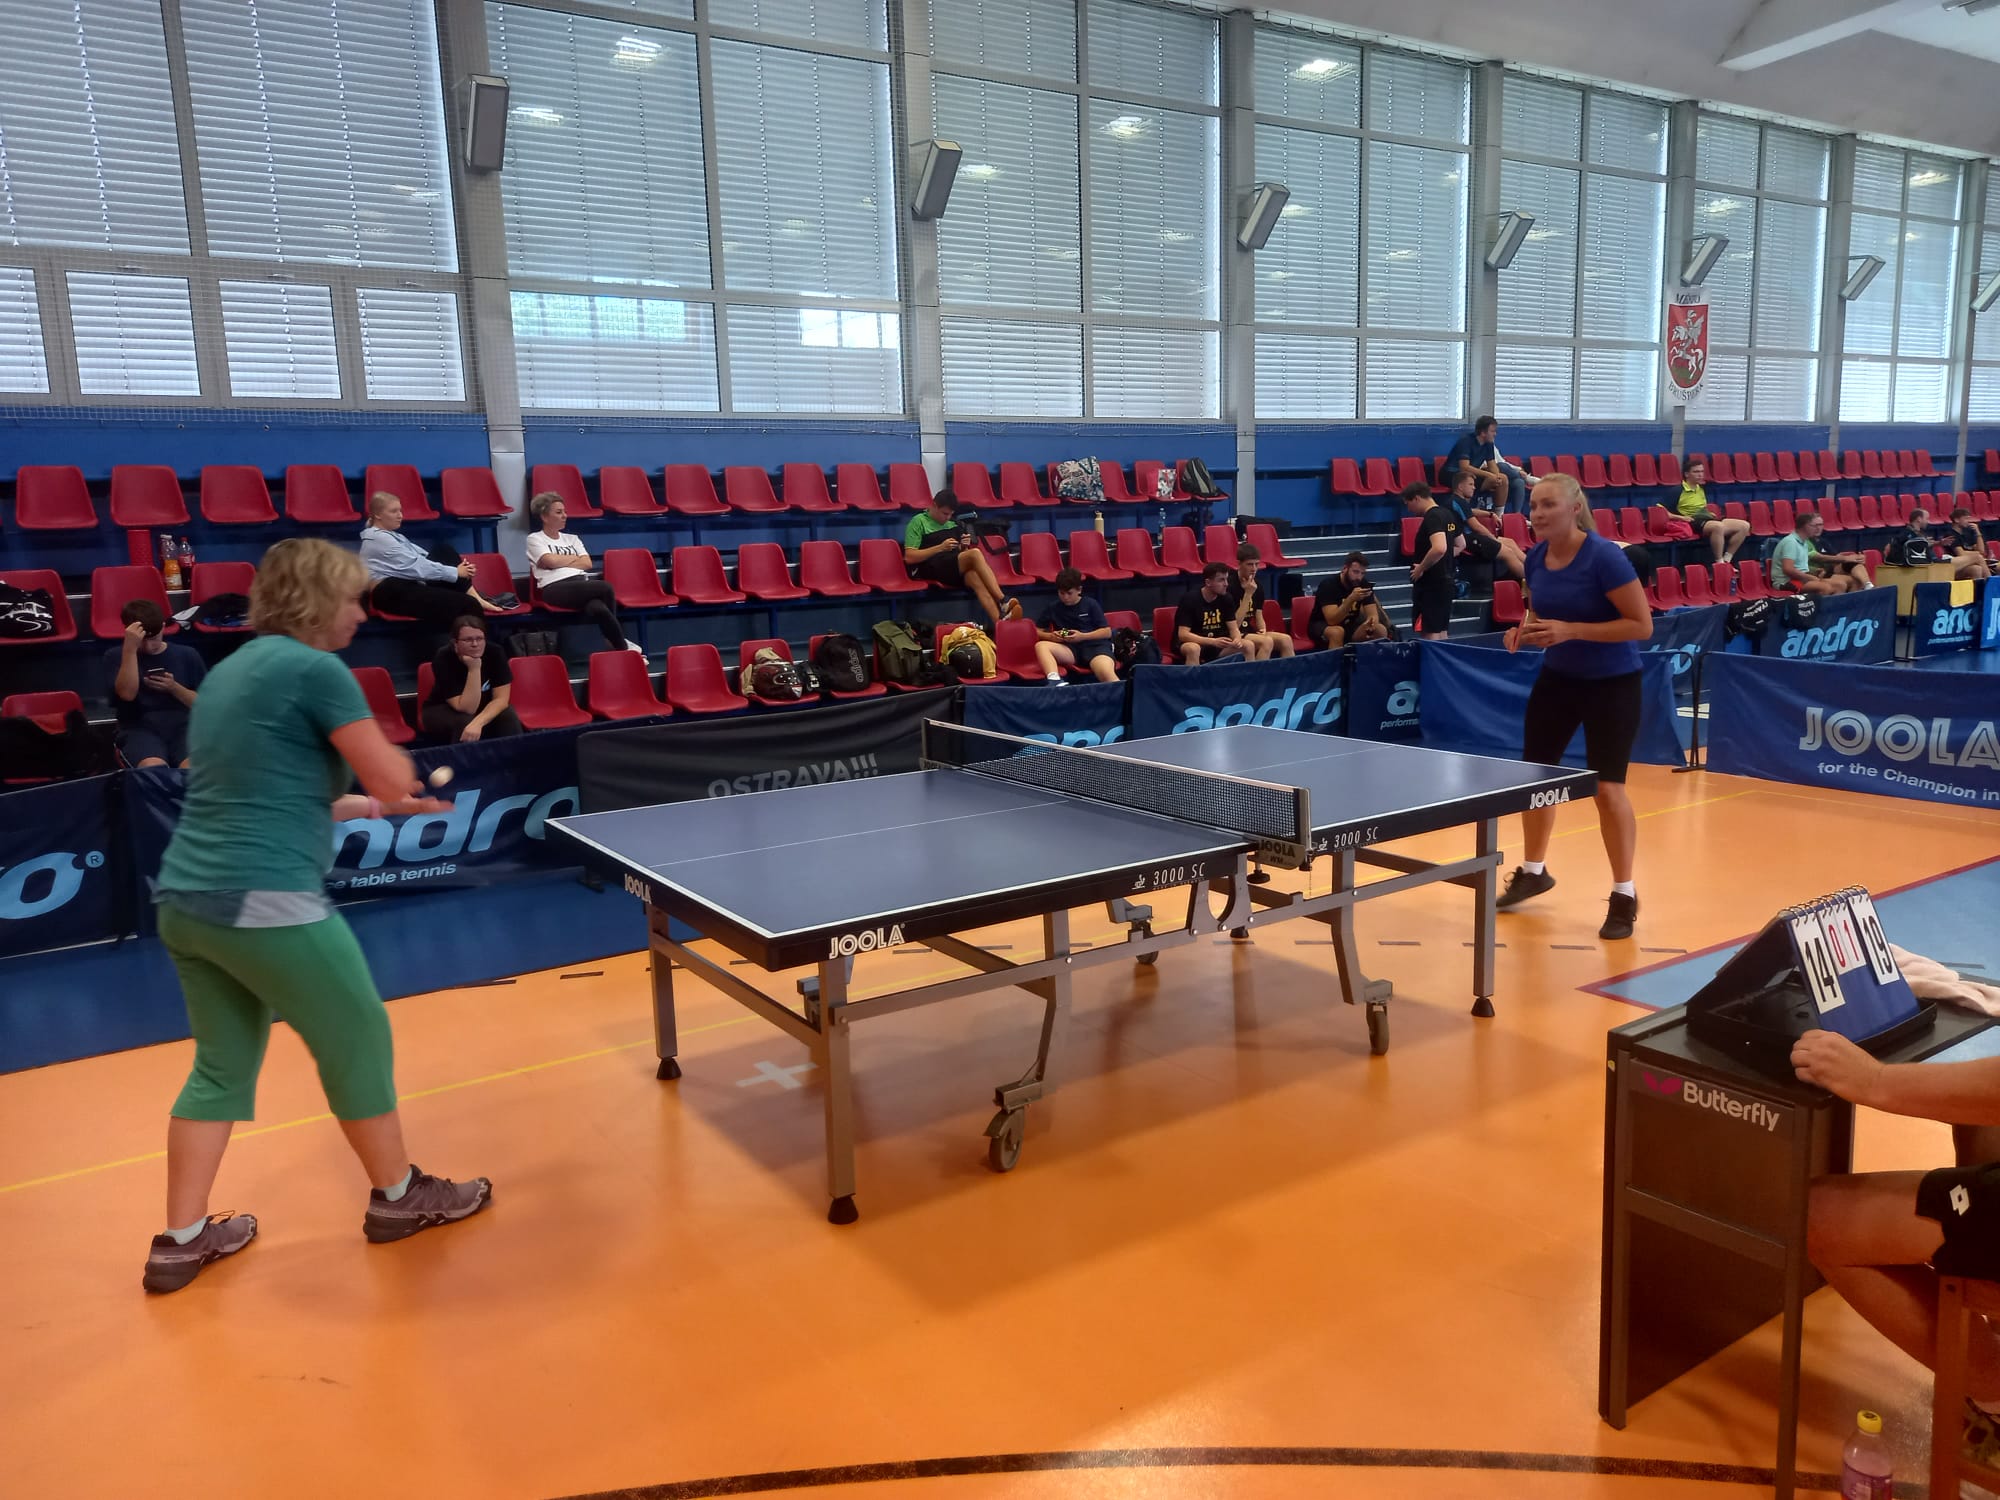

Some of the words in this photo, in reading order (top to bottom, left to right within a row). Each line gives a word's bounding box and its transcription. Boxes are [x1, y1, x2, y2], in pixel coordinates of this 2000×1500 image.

[1781, 617, 1874, 658] andro
[848, 648, 864, 683] adidas
[1799, 706, 2000, 770] JOOLA
[708, 753, 878, 798] OSTRAVA!!!
[1817, 762, 1844, 775] for
[1849, 762, 1878, 777] the
[1883, 768, 1977, 800] Champion
[1529, 786, 1570, 810] JOOLA
[324, 786, 580, 874] ndro
[1334, 830, 1361, 848] 3000
[1366, 826, 1379, 842] SC
[350, 871, 397, 889] table
[400, 862, 457, 881] tennis
[624, 873, 652, 905] JOOLA
[1153, 865, 1184, 886] 3000
[1191, 862, 1206, 879] SC
[829, 924, 905, 960] JOOLA
[1805, 937, 1838, 1003] 14
[1862, 915, 1893, 976] 19
[1683, 1081, 1780, 1132] Butterfly
